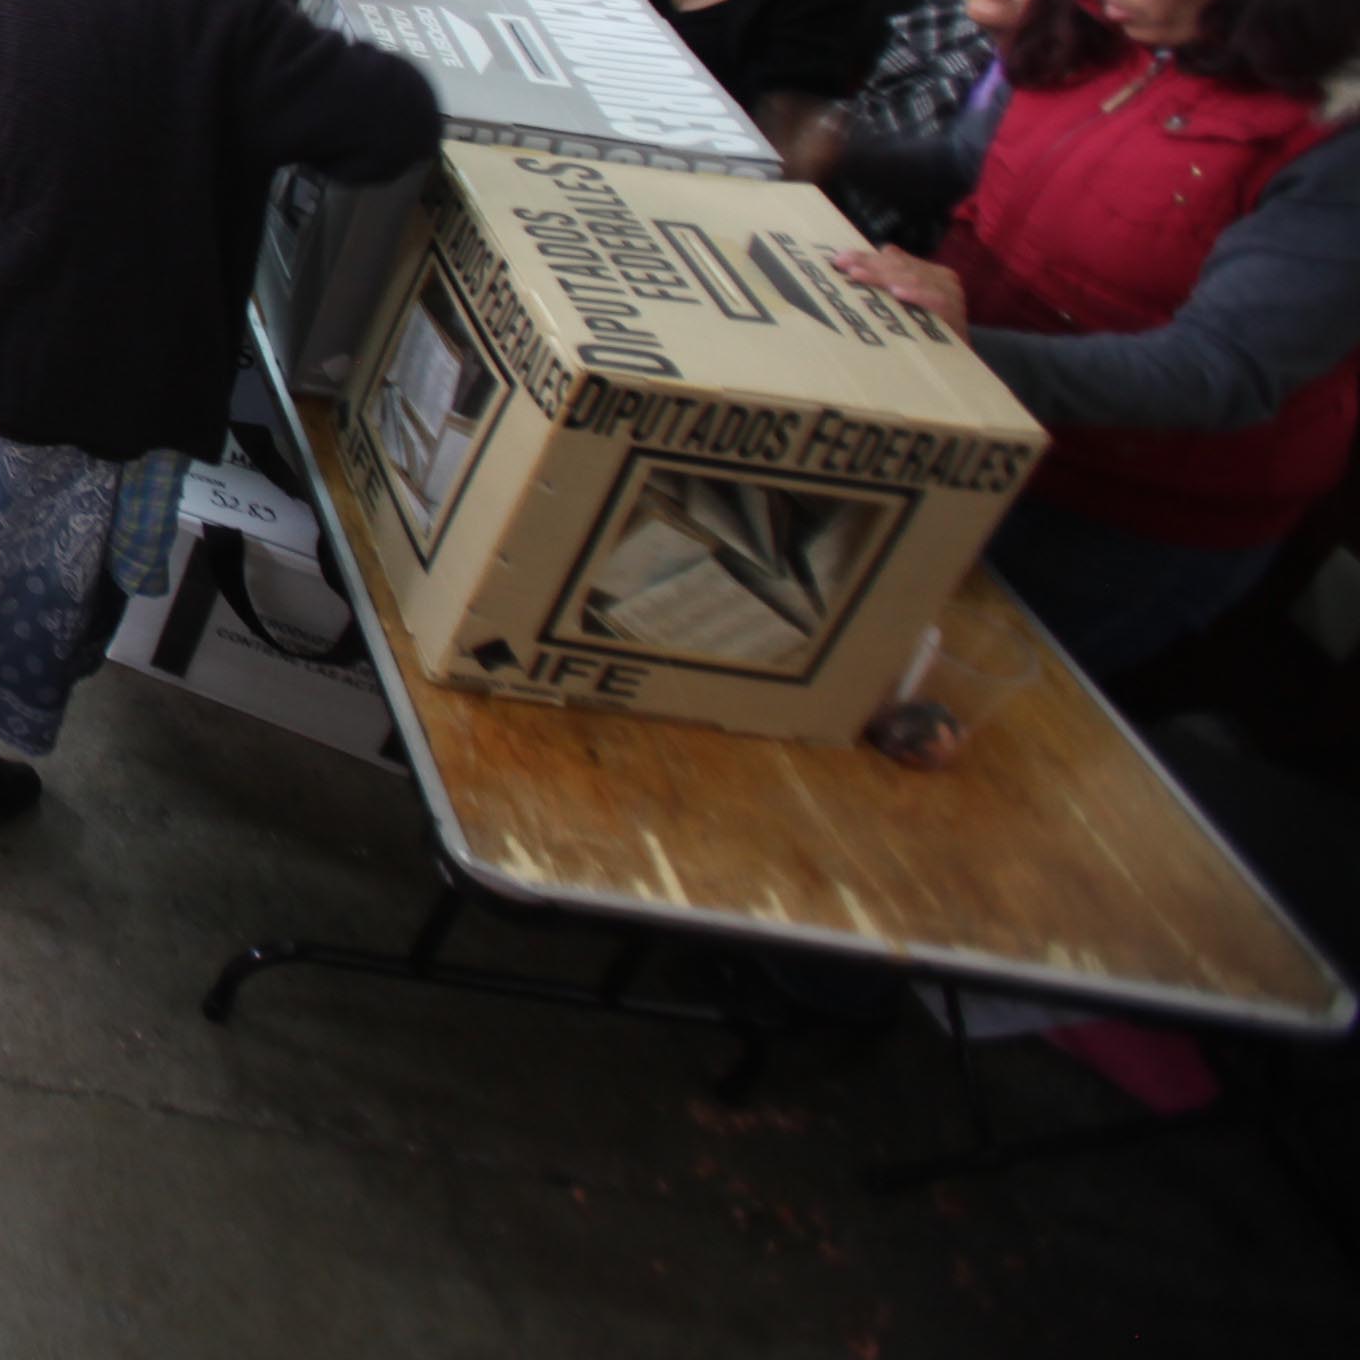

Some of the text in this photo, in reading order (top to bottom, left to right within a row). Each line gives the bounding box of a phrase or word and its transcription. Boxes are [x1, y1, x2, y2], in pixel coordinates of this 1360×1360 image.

[512, 207, 684, 379] DIPUTADOS
[513, 157, 704, 305] FEDERALES
[563, 372, 1032, 493] DIPUTADOS FEDERALES
[528, 649, 651, 699] IFE
